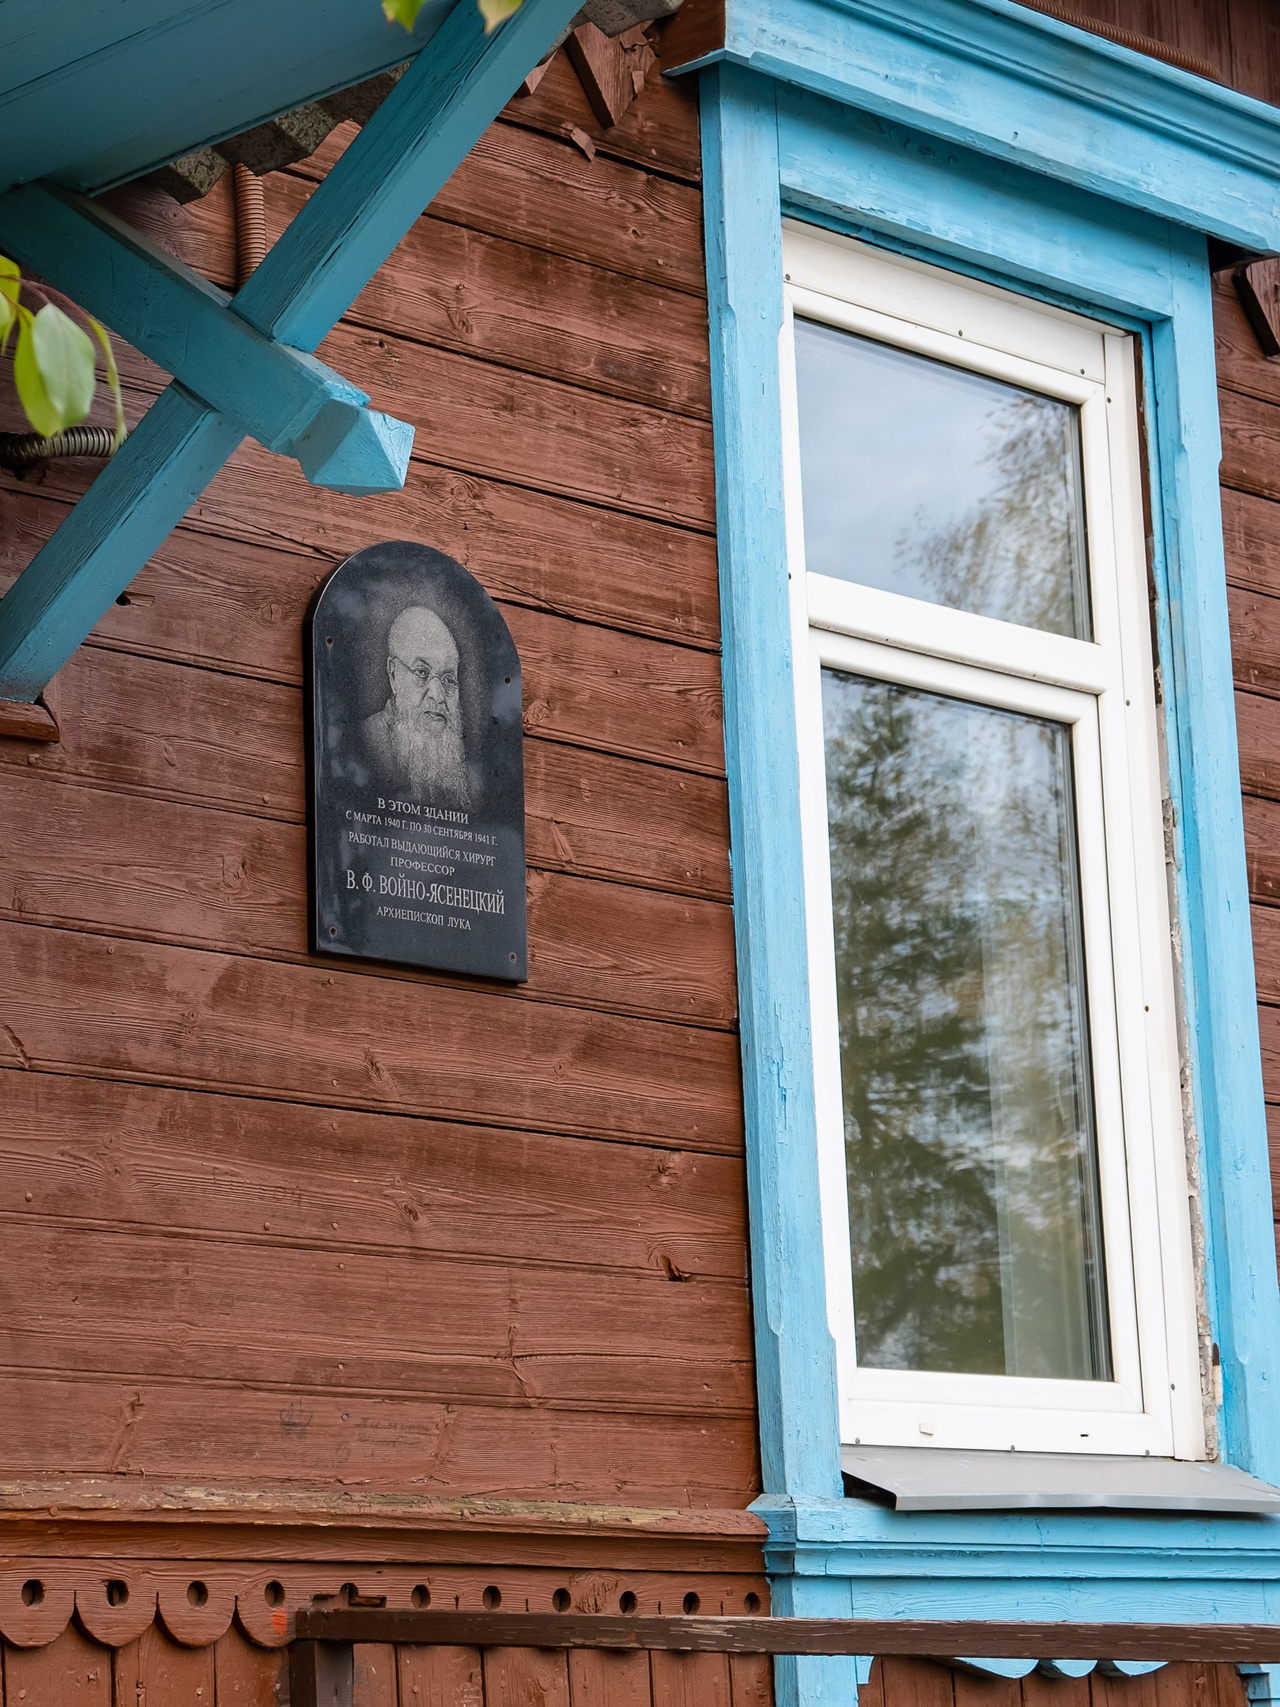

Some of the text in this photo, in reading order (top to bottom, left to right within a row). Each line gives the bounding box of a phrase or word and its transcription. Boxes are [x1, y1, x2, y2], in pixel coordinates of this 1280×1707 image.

[377, 797, 469, 825] В ЭТОМ ЗДАНИИ
[345, 810, 498, 846] С МАРТА 1940 Г. ПО 30 СЕНТЯБРЯ 1941 Г.
[348, 831, 497, 866] РАБОТАЛ ВЫДАЮЩИЙСЯ ХИРУРГ
[390, 856, 455, 876] ПРОФЕССОР
[346, 869, 505, 915] В. Ф. ВОЙНО-ЯСЕНЕЦКИЙ
[376, 906, 472, 930] АРХИЕПИСКОП ЛУКА
